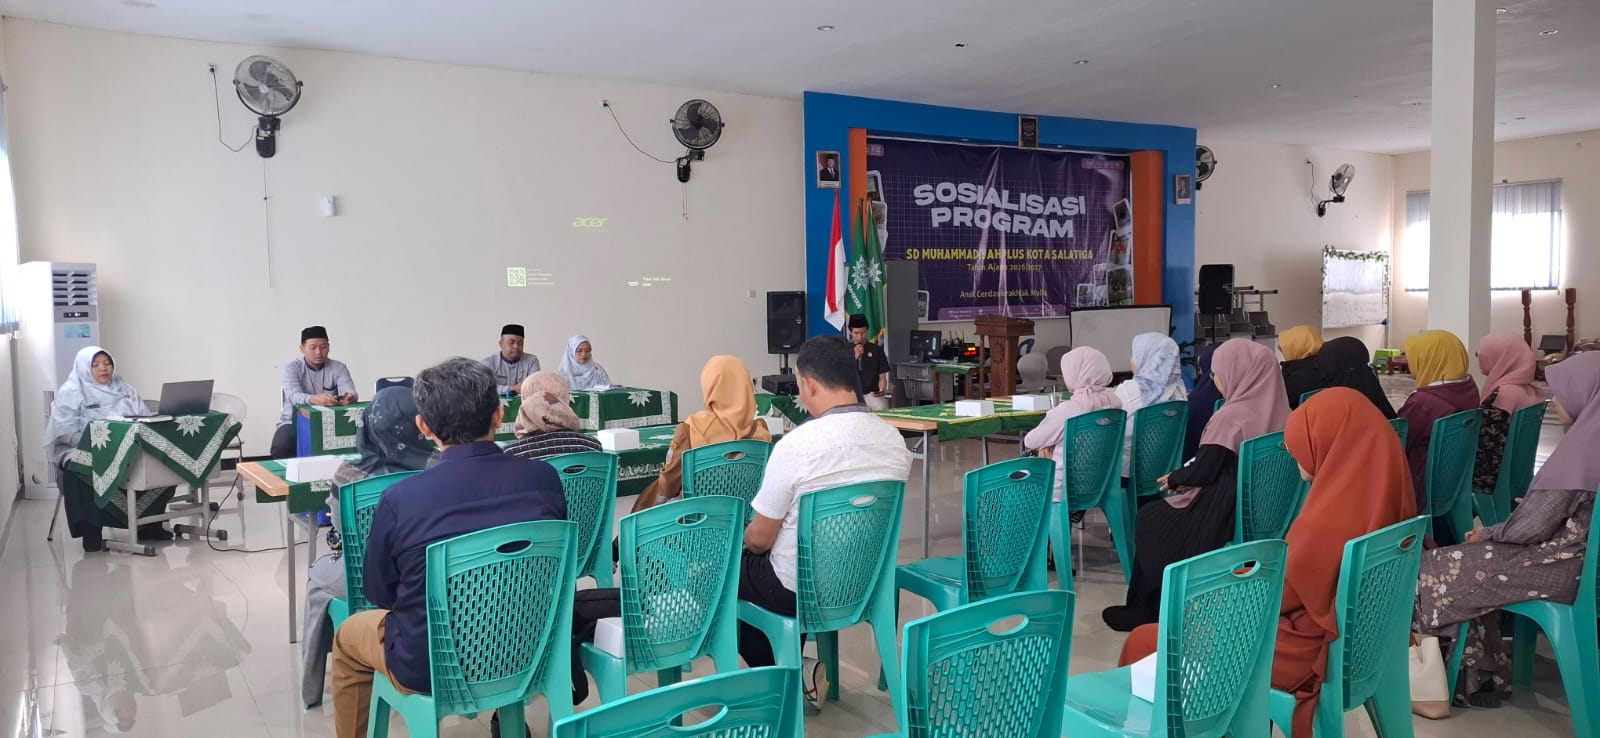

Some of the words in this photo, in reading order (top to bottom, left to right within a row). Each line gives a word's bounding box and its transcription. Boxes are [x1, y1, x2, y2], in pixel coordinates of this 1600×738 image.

[913, 182, 1086, 216] SOSIALISASI
[573, 217, 608, 227] acer
[931, 207, 1074, 238] PROGRAM
[906, 248, 920, 260] SD
[1026, 248, 1050, 260] KOTA
[1051, 249, 1093, 260] SALATIGA
